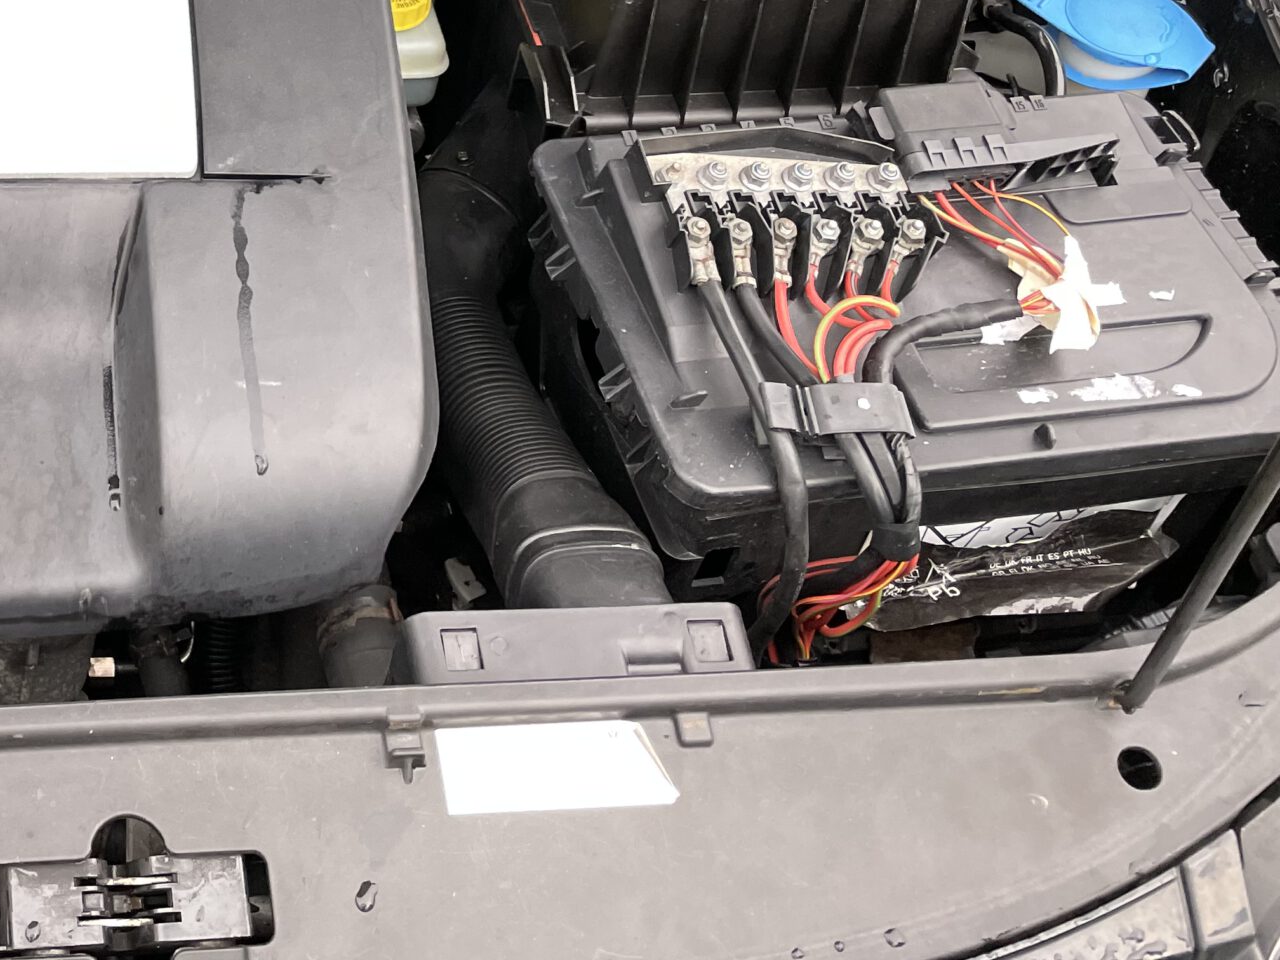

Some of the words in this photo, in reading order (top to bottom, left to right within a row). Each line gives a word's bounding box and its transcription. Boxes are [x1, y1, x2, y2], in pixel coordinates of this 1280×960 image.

[822, 115, 833, 128] 6
[1035, 554, 1044, 562] IT
[1047, 552, 1059, 560] ES
[1063, 549, 1074, 558] PT
[927, 584, 960, 600] Pb
